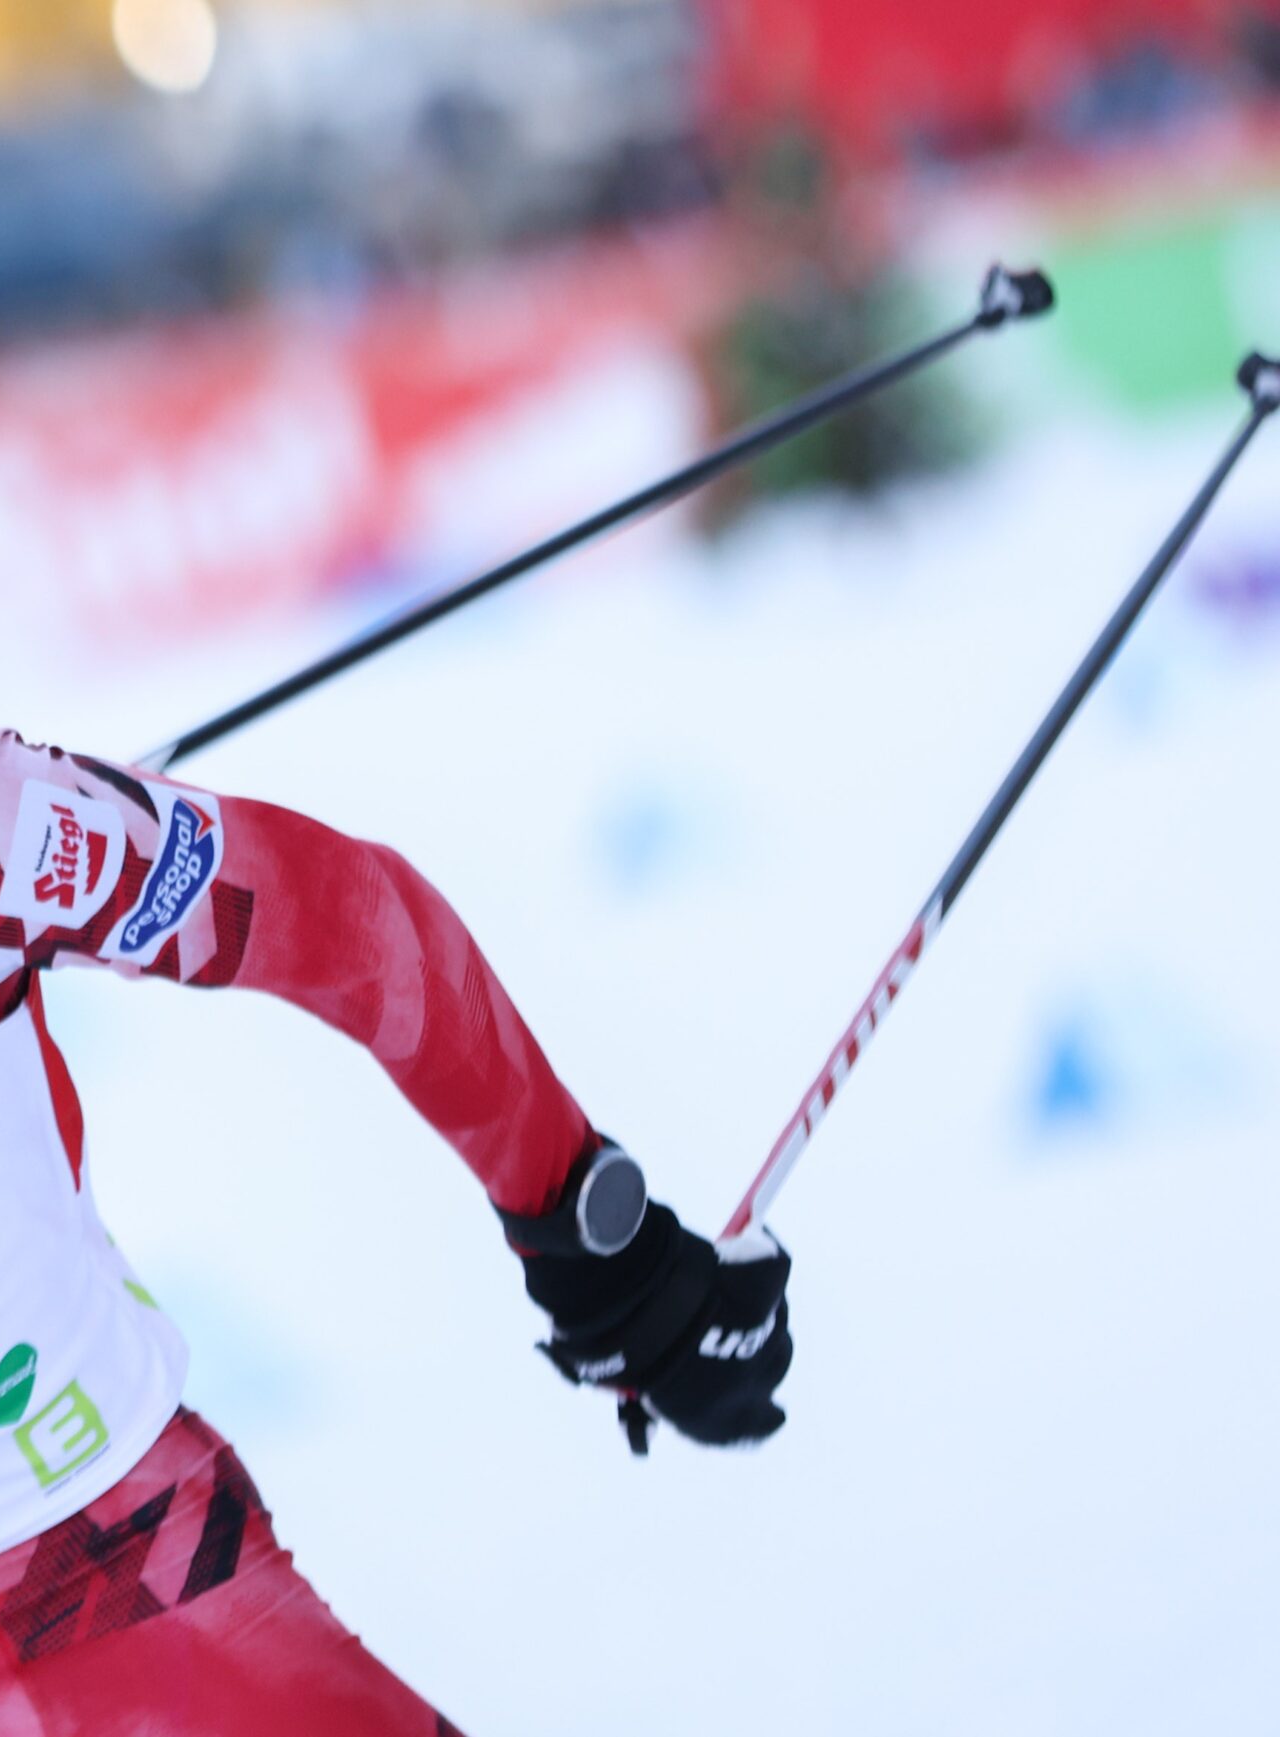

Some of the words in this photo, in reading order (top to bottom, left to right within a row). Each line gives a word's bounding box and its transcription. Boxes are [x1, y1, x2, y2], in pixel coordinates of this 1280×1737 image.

[33, 803, 84, 910] Stiegl
[124, 812, 192, 946] personal
[156, 853, 202, 926] shop
